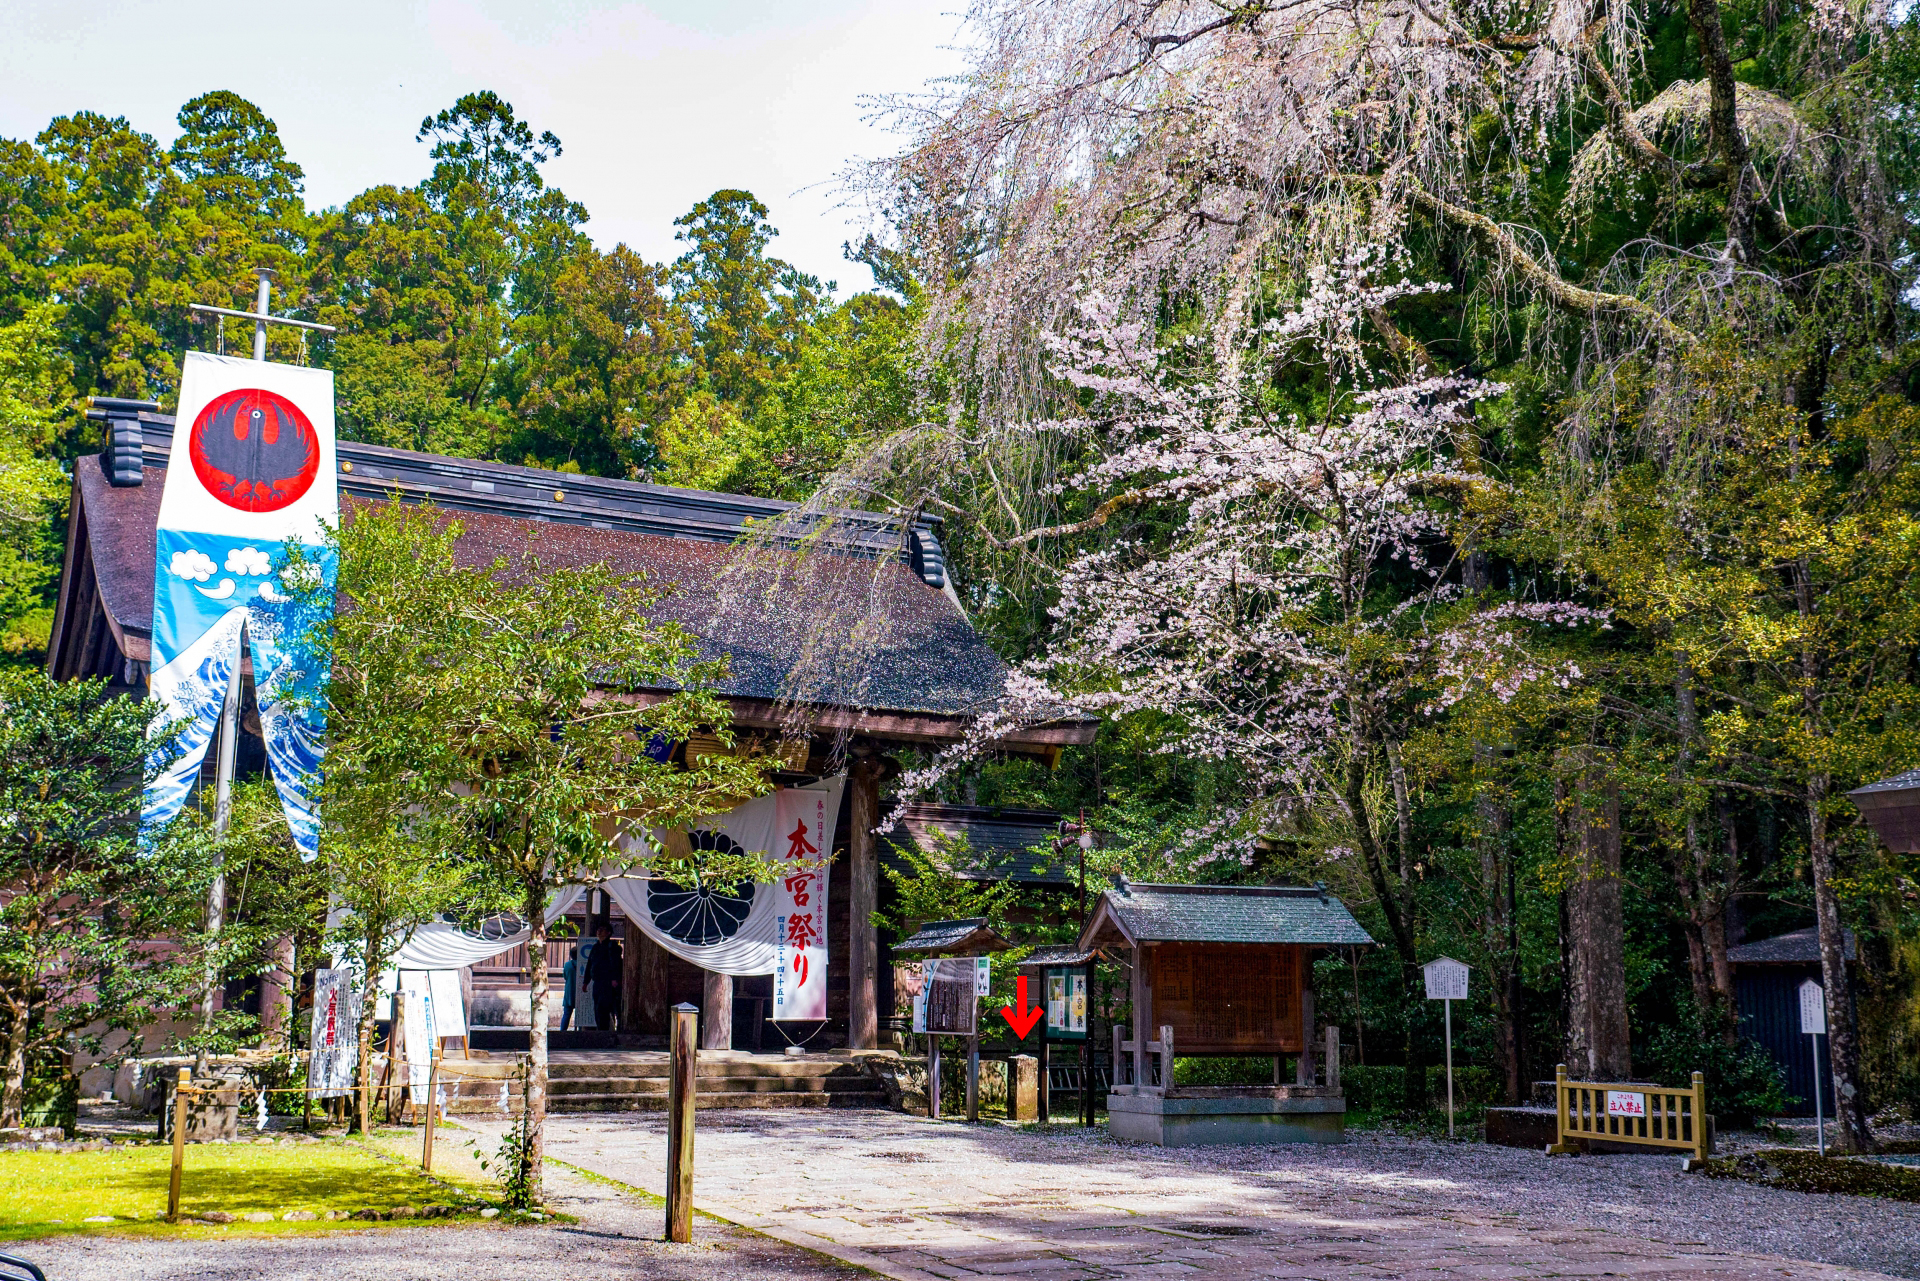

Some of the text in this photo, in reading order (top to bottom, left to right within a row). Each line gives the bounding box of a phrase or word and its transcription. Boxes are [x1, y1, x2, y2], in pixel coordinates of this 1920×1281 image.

[785, 817, 818, 989] 本宮祭り
[776, 916, 786, 1005] 四月十三・十四・十五日
[325, 987, 338, 1047] 火気厳禁
[1610, 1101, 1642, 1113] 立入禁止
